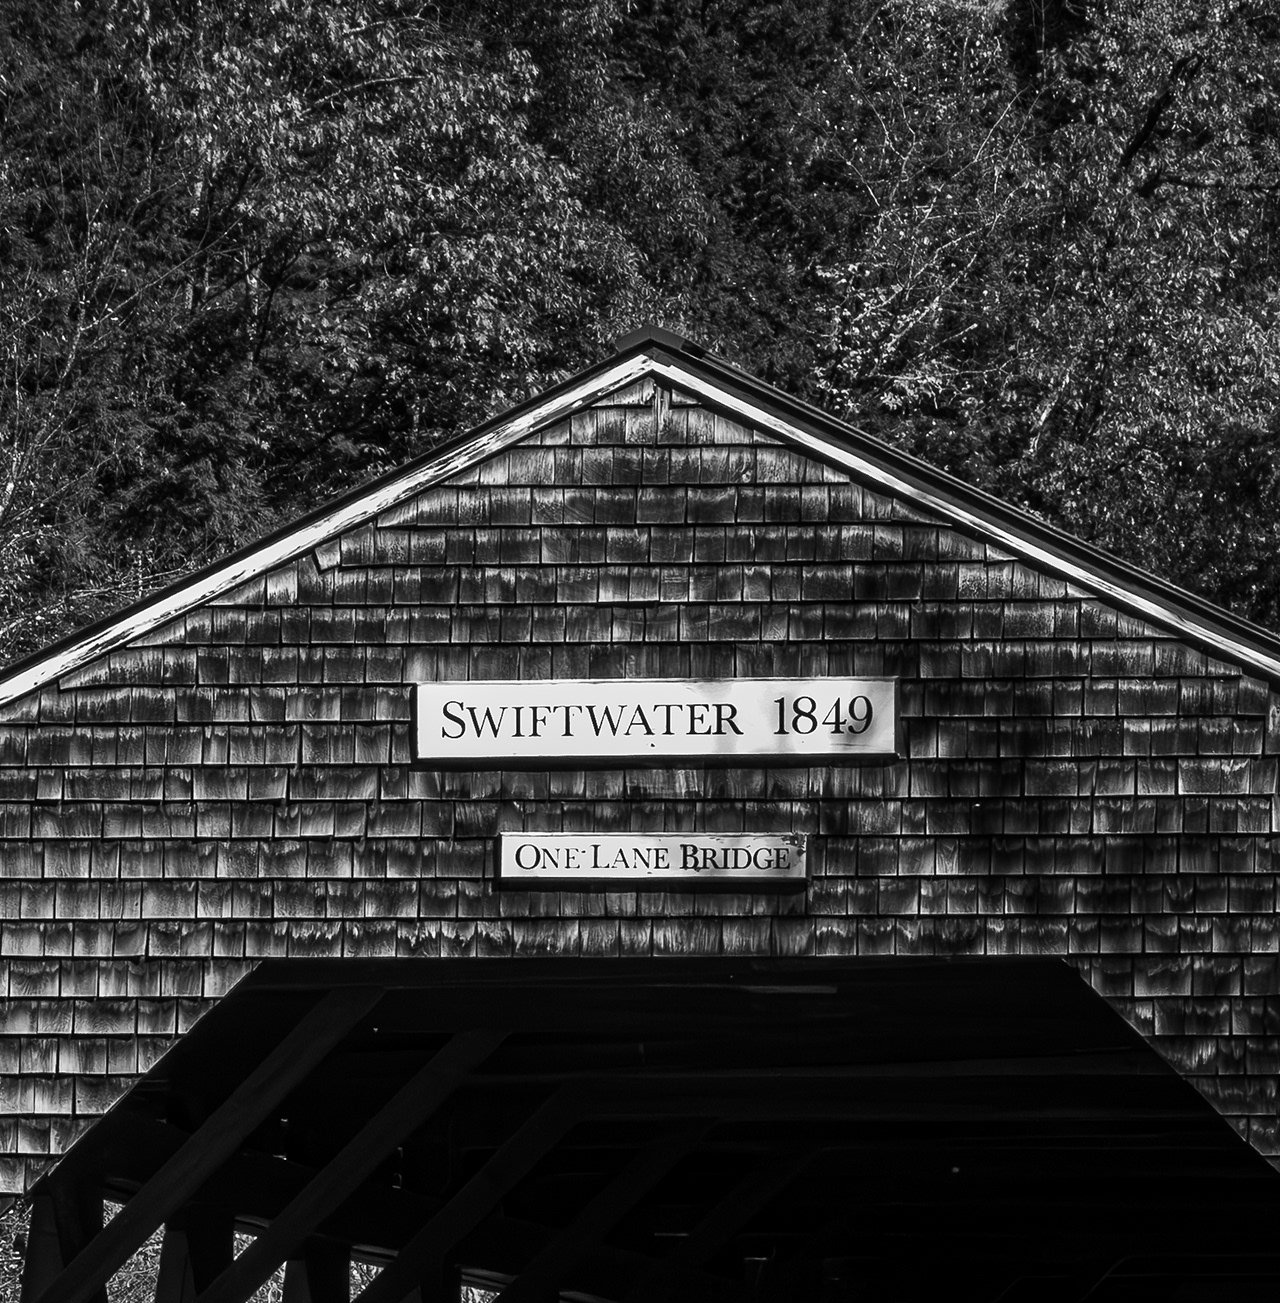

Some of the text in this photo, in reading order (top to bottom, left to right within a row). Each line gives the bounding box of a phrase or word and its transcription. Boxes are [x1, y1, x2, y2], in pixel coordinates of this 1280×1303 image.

[441, 695, 874, 739] SWIFTWATER 1849
[515, 843, 791, 872] ONE LANE BRIDGE
